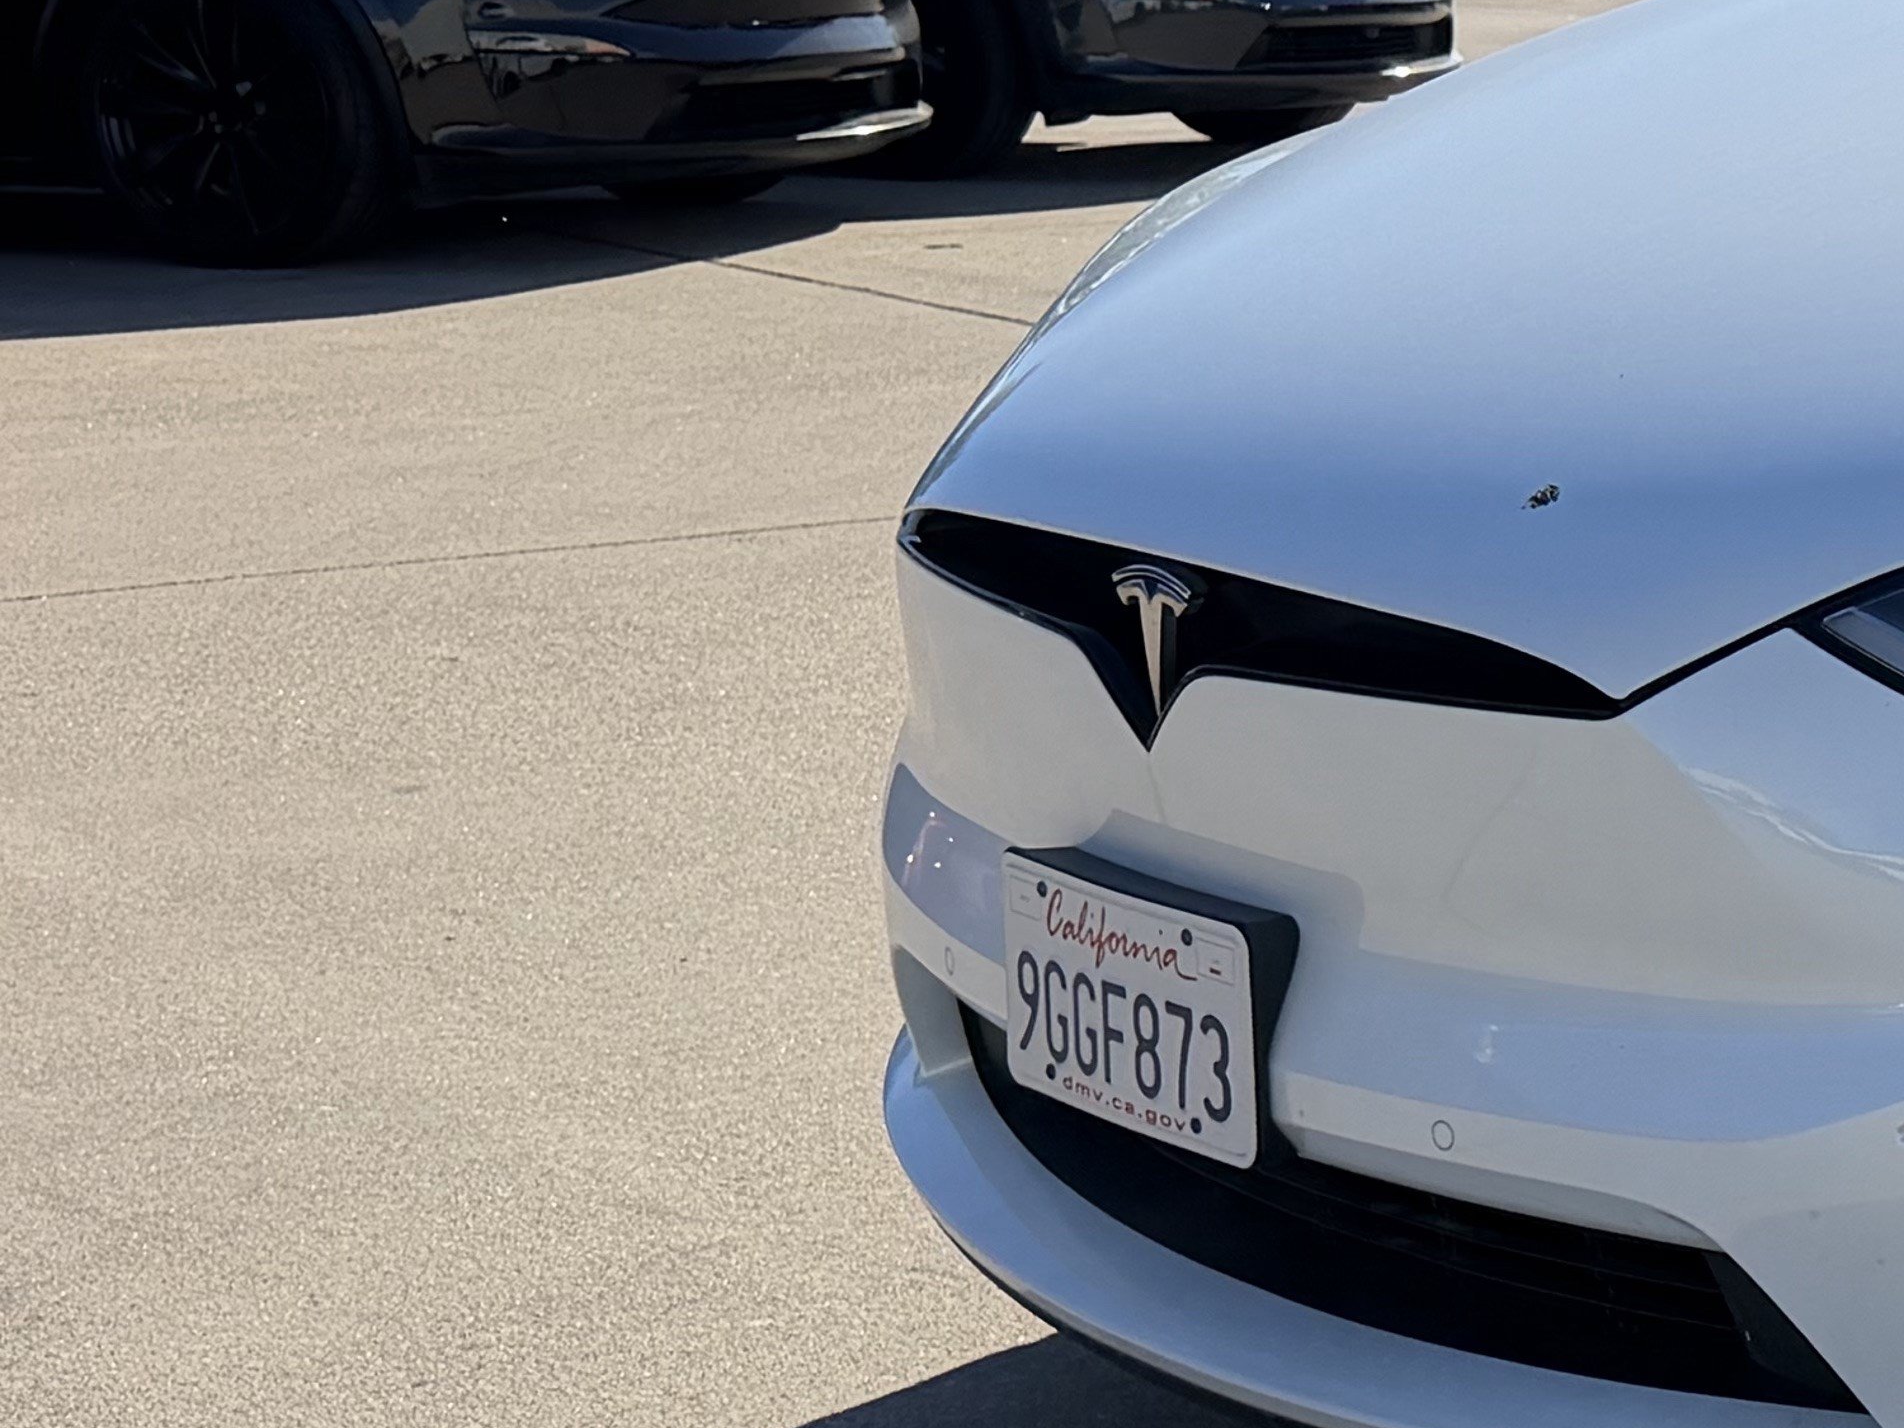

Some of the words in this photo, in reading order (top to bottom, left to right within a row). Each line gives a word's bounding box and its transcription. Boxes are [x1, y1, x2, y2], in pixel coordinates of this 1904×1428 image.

[1046, 887, 1198, 982] California
[1017, 949, 1232, 1123] 9GGF873
[1062, 1074, 1187, 1133] dmv.ca.gov
